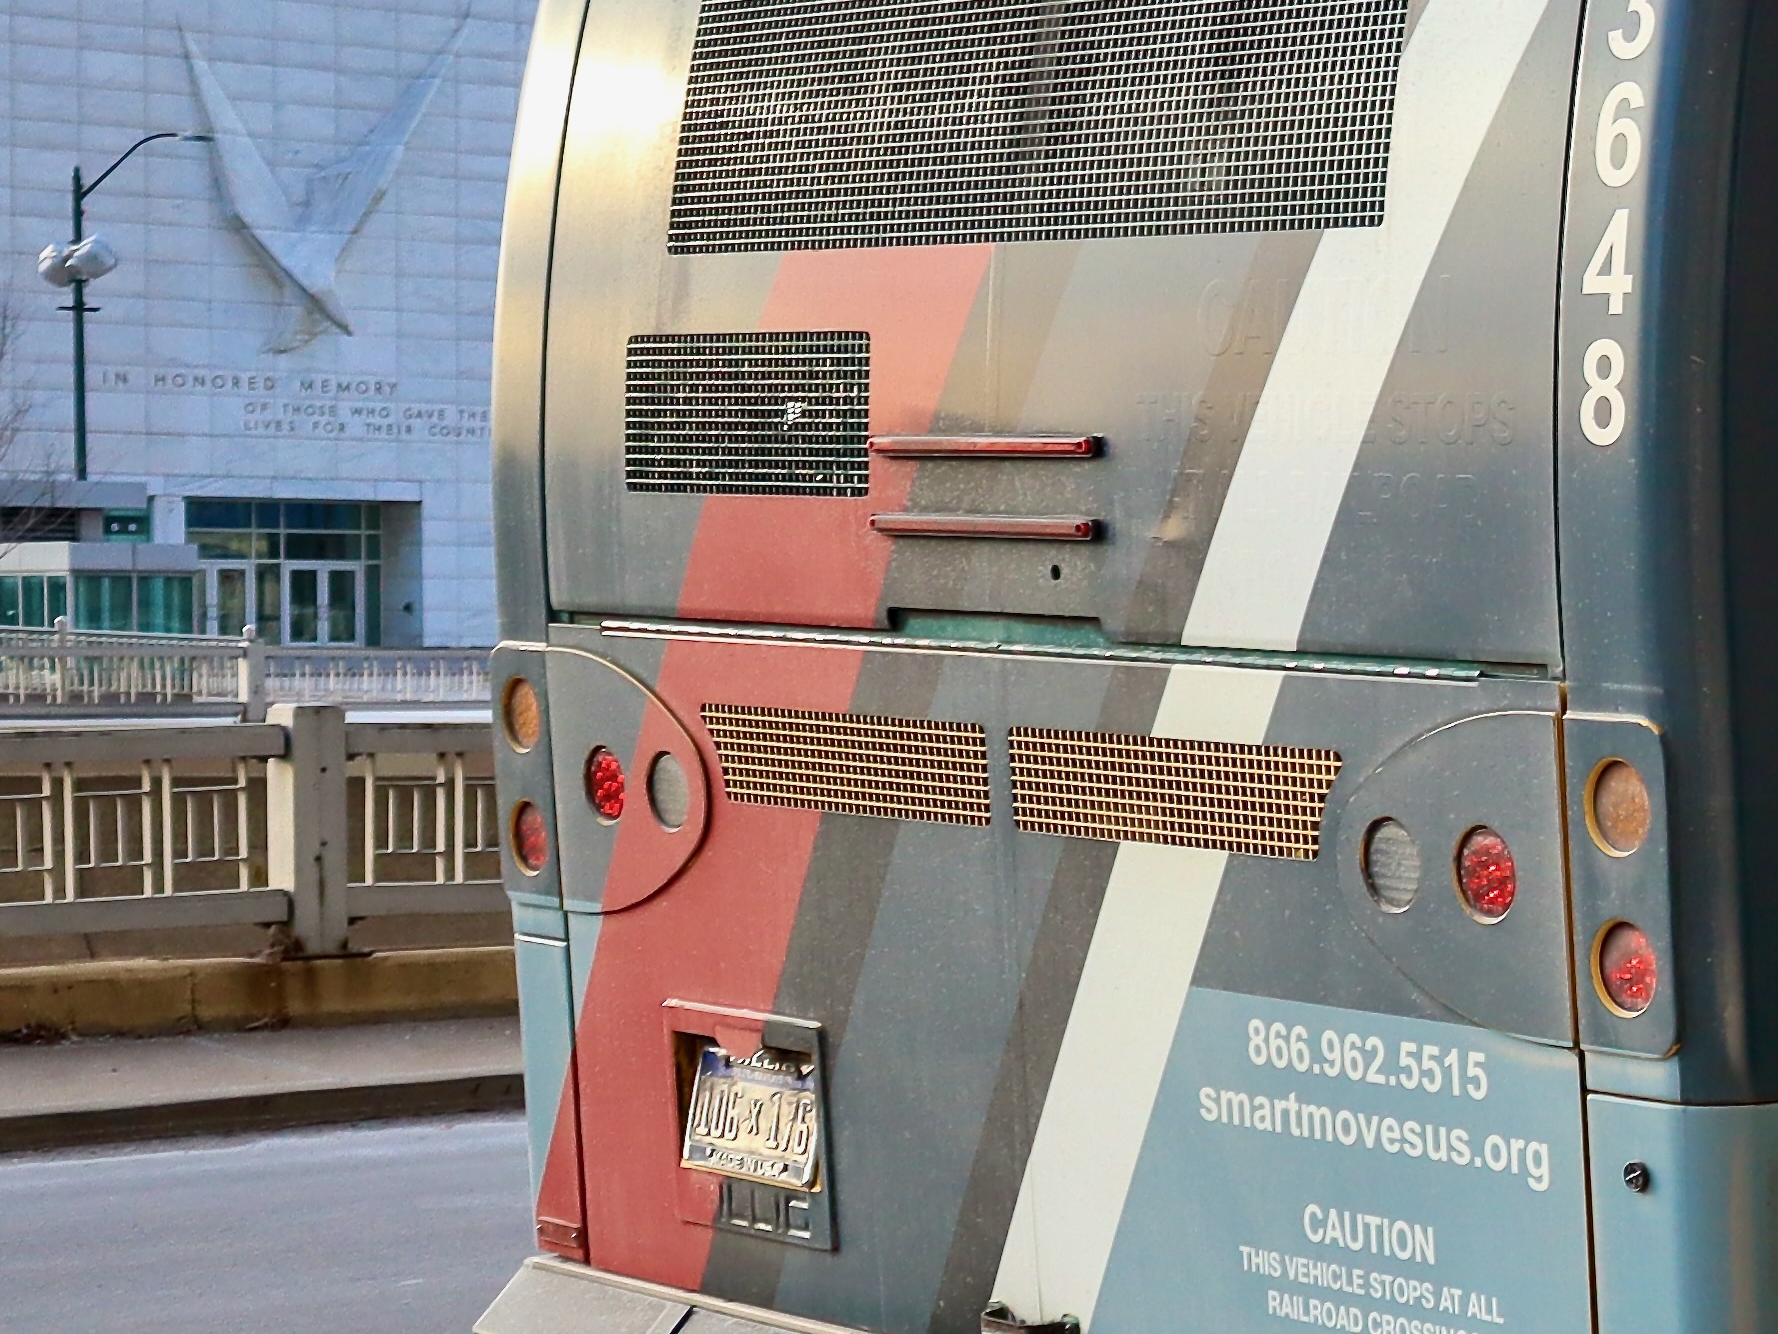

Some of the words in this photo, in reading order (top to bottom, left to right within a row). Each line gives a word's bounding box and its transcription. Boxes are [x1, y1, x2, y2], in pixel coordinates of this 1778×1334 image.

[101, 372, 130, 386] IN
[152, 372, 277, 393] HONORED
[299, 378, 399, 397] MEMORY
[243, 402, 270, 415] OF
[281, 403, 338, 419] THOSE
[349, 406, 391, 420] WHO
[402, 407, 447, 422] GAVE
[457, 408, 491, 424] THE
[243, 419, 297, 433] LIVES
[311, 420, 347, 435] FOR
[364, 422, 413, 437] THEIR
[428, 423, 491, 438] COUNT
[1247, 1017, 1489, 1101] 866.962.5515
[1199, 1085, 1550, 1192] smartmovesus.org
[1302, 1203, 1436, 1266] CAUTION
[1239, 1245, 1282, 1279] THIS
[1284, 1254, 1365, 1296] VEHICLE
[1369, 1272, 1435, 1311] STOPS
[1439, 1286, 1463, 1315] AT
[1467, 1295, 1505, 1325] ALL
[1267, 1289, 1362, 1334] RAILROAD
